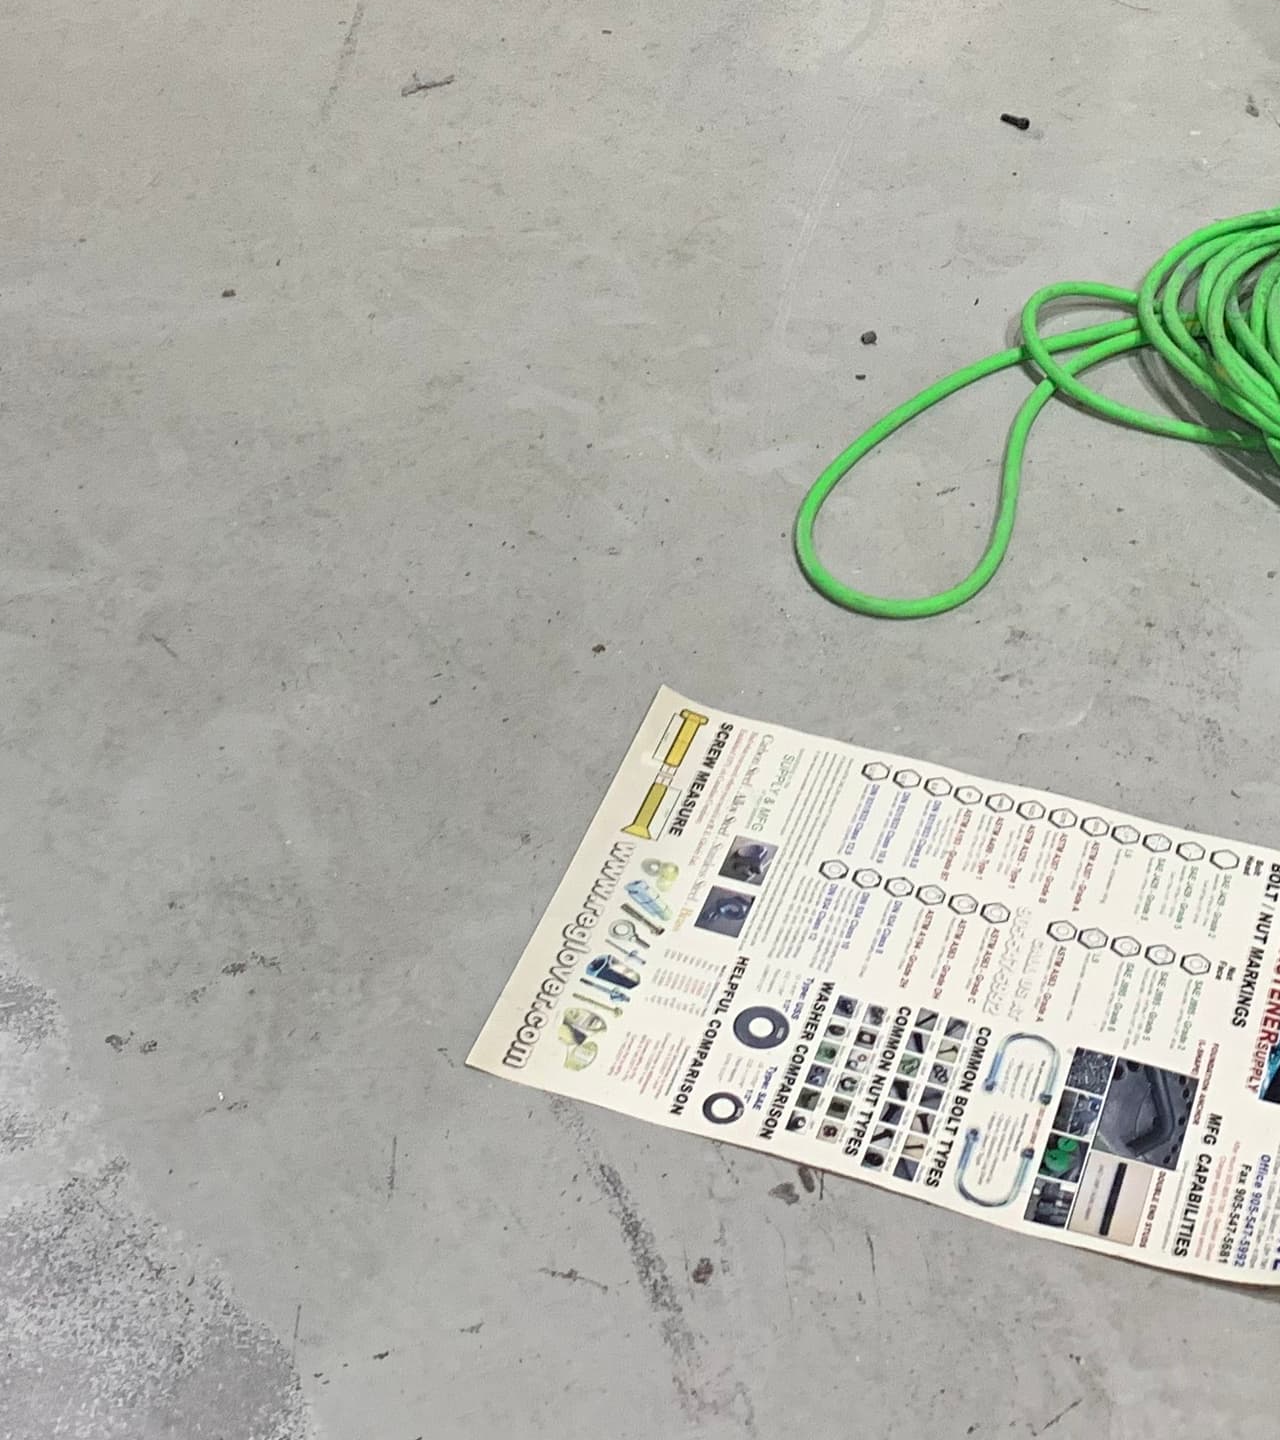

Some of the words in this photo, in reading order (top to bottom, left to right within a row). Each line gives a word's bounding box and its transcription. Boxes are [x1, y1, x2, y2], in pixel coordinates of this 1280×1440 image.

[702, 723, 732, 768] SCREW
[769, 754, 794, 795] SUPPLY
[668, 771, 709, 835] MEASURE
[750, 807, 770, 831] MFG
[501, 842, 637, 1069] www.reglover.com
[1253, 912, 1272, 944] NUT
[714, 956, 748, 1014] HELPFUL
[801, 982, 833, 1040] WASHER
[1232, 947, 1263, 1026] MARKINGS
[670, 1019, 720, 1114] COMPARISON
[878, 1006, 910, 1070] COMMON
[959, 1027, 990, 1091] COMMON
[760, 1045, 807, 1138] COMPARISON
[865, 1074, 885, 1106] NUT
[945, 1095, 967, 1135] BOLT
[844, 1111, 872, 1155] TYPES
[1202, 1113, 1221, 1144] MFG
[925, 1140, 953, 1187] TYPES
[1237, 1164, 1251, 1184] Fax
[1254, 1154, 1270, 1188] Office
[1173, 1154, 1210, 1256] CAPABILITIES
[1218, 1188, 1245, 1263] 905-547-5681
[1234, 1192, 1261, 1267] 905-547-5992
